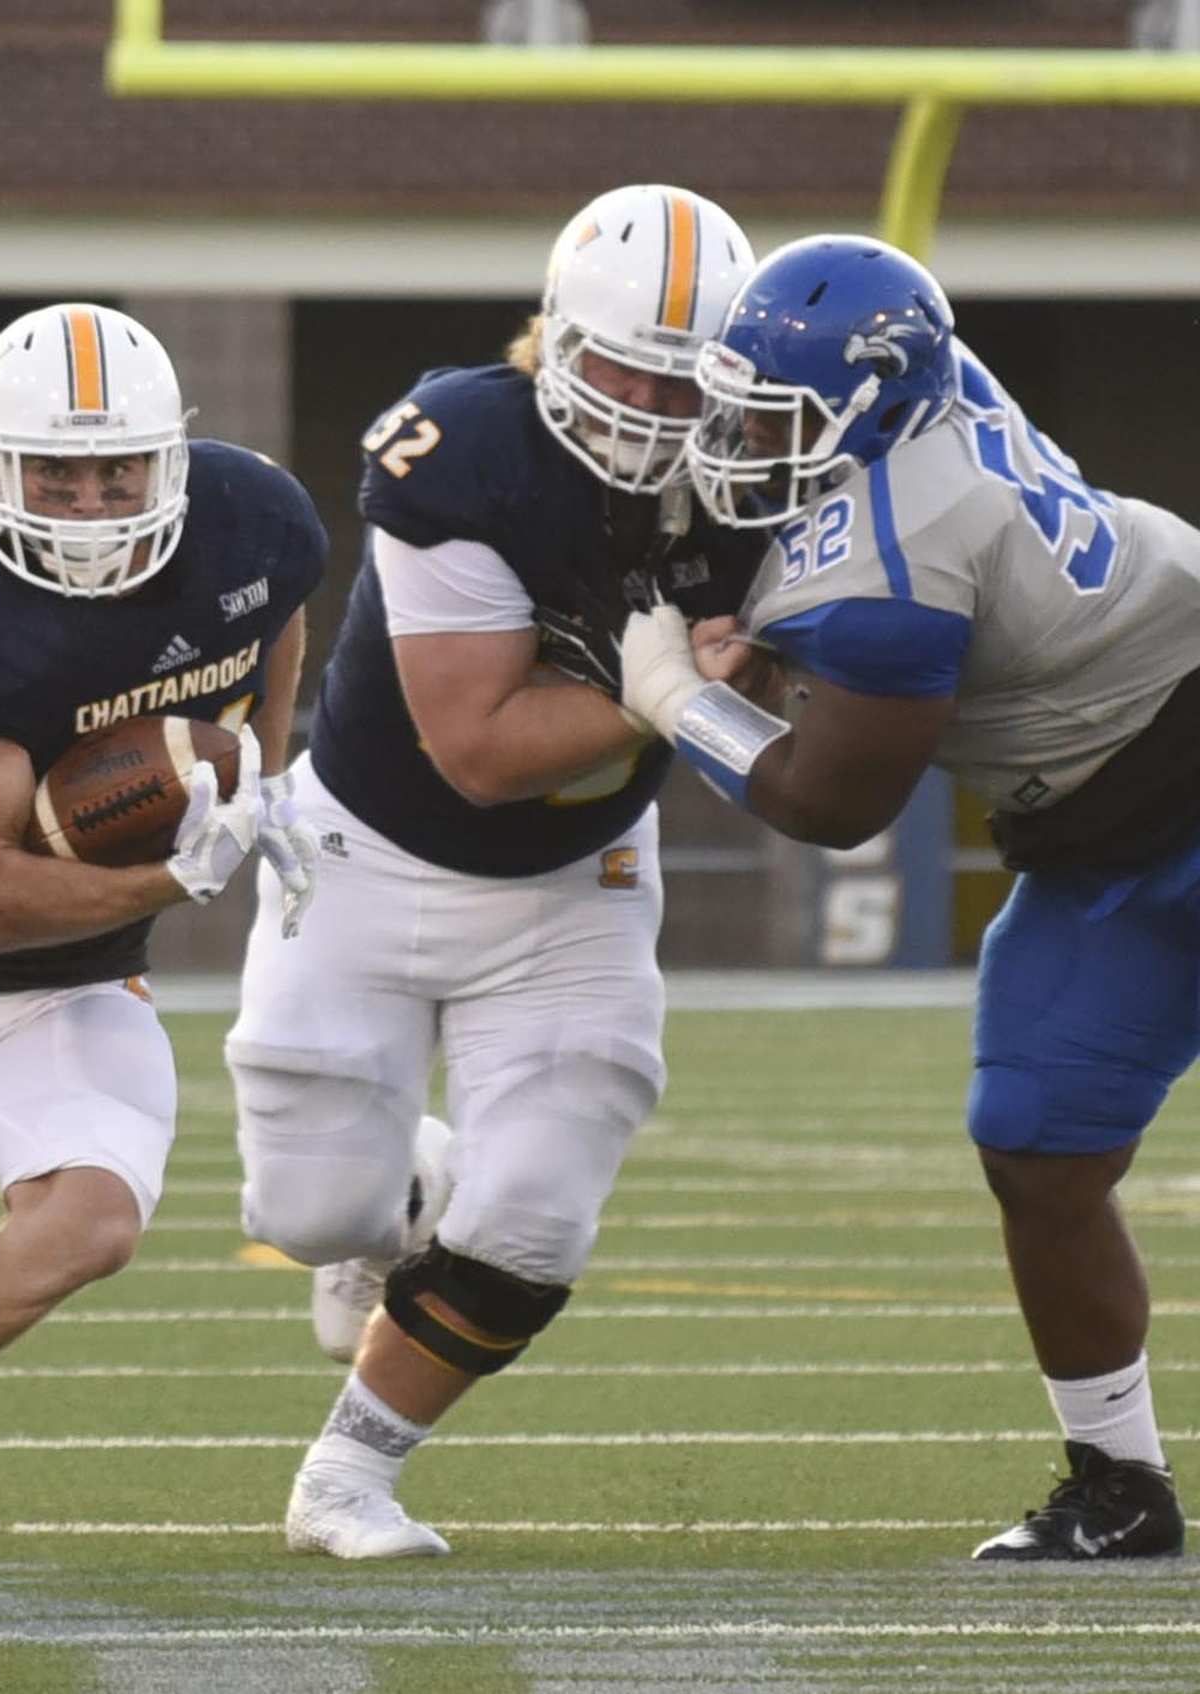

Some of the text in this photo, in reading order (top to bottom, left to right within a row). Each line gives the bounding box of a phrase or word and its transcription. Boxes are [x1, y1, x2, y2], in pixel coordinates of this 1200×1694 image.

[362, 399, 443, 480] 52
[777, 493, 855, 592] 52
[75, 638, 263, 735] CHATTANOOGA
[151, 646, 202, 675] adidas
